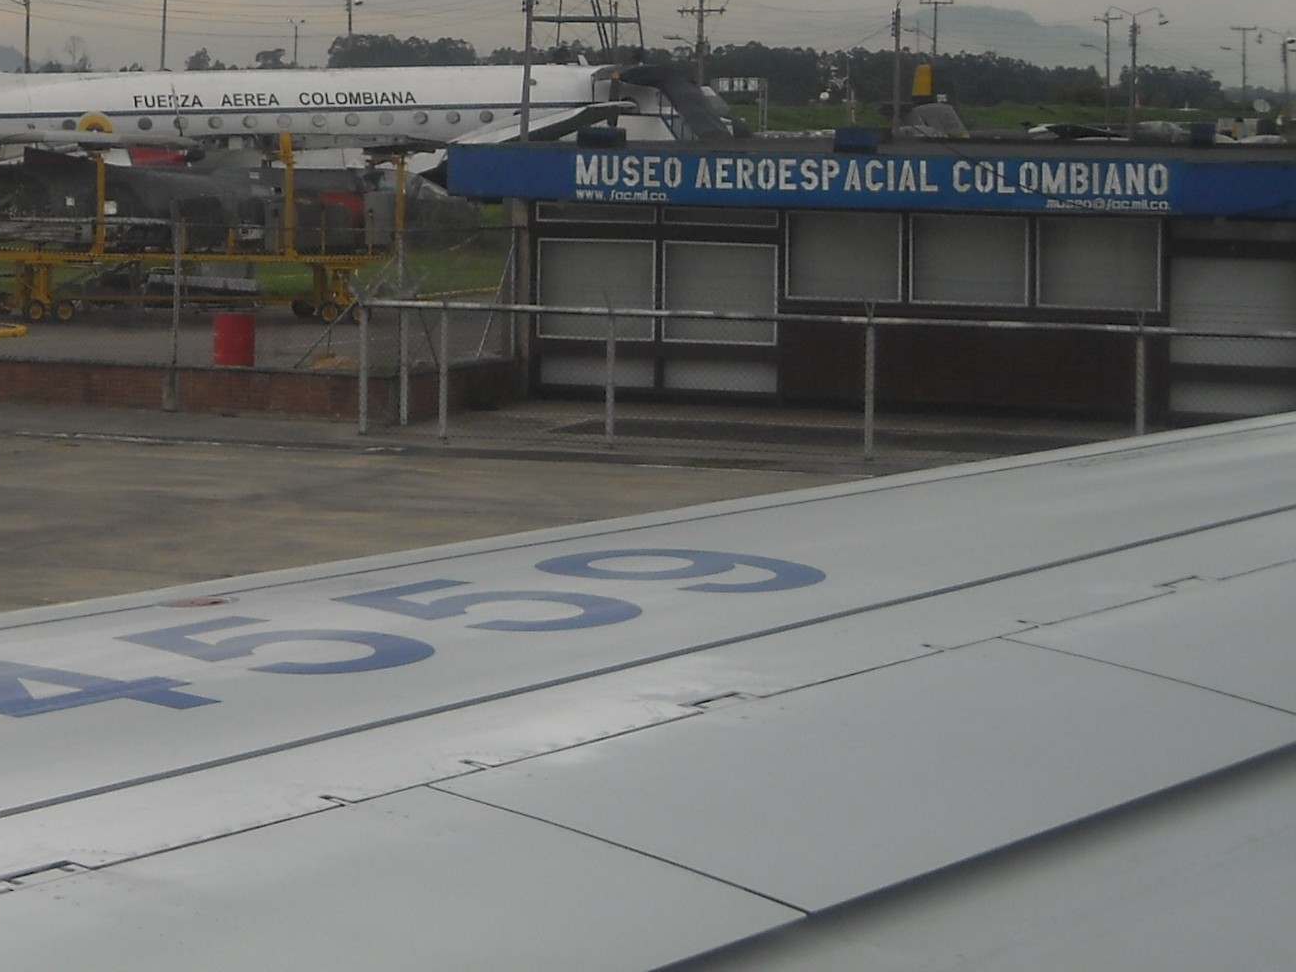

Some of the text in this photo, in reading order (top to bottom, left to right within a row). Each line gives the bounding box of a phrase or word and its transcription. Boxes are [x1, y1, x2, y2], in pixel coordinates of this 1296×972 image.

[133, 91, 417, 109] FUERZA AEREA COLOMBIANA
[575, 154, 1170, 196] MUSEO AEROESPACIAL COLOMBIANO
